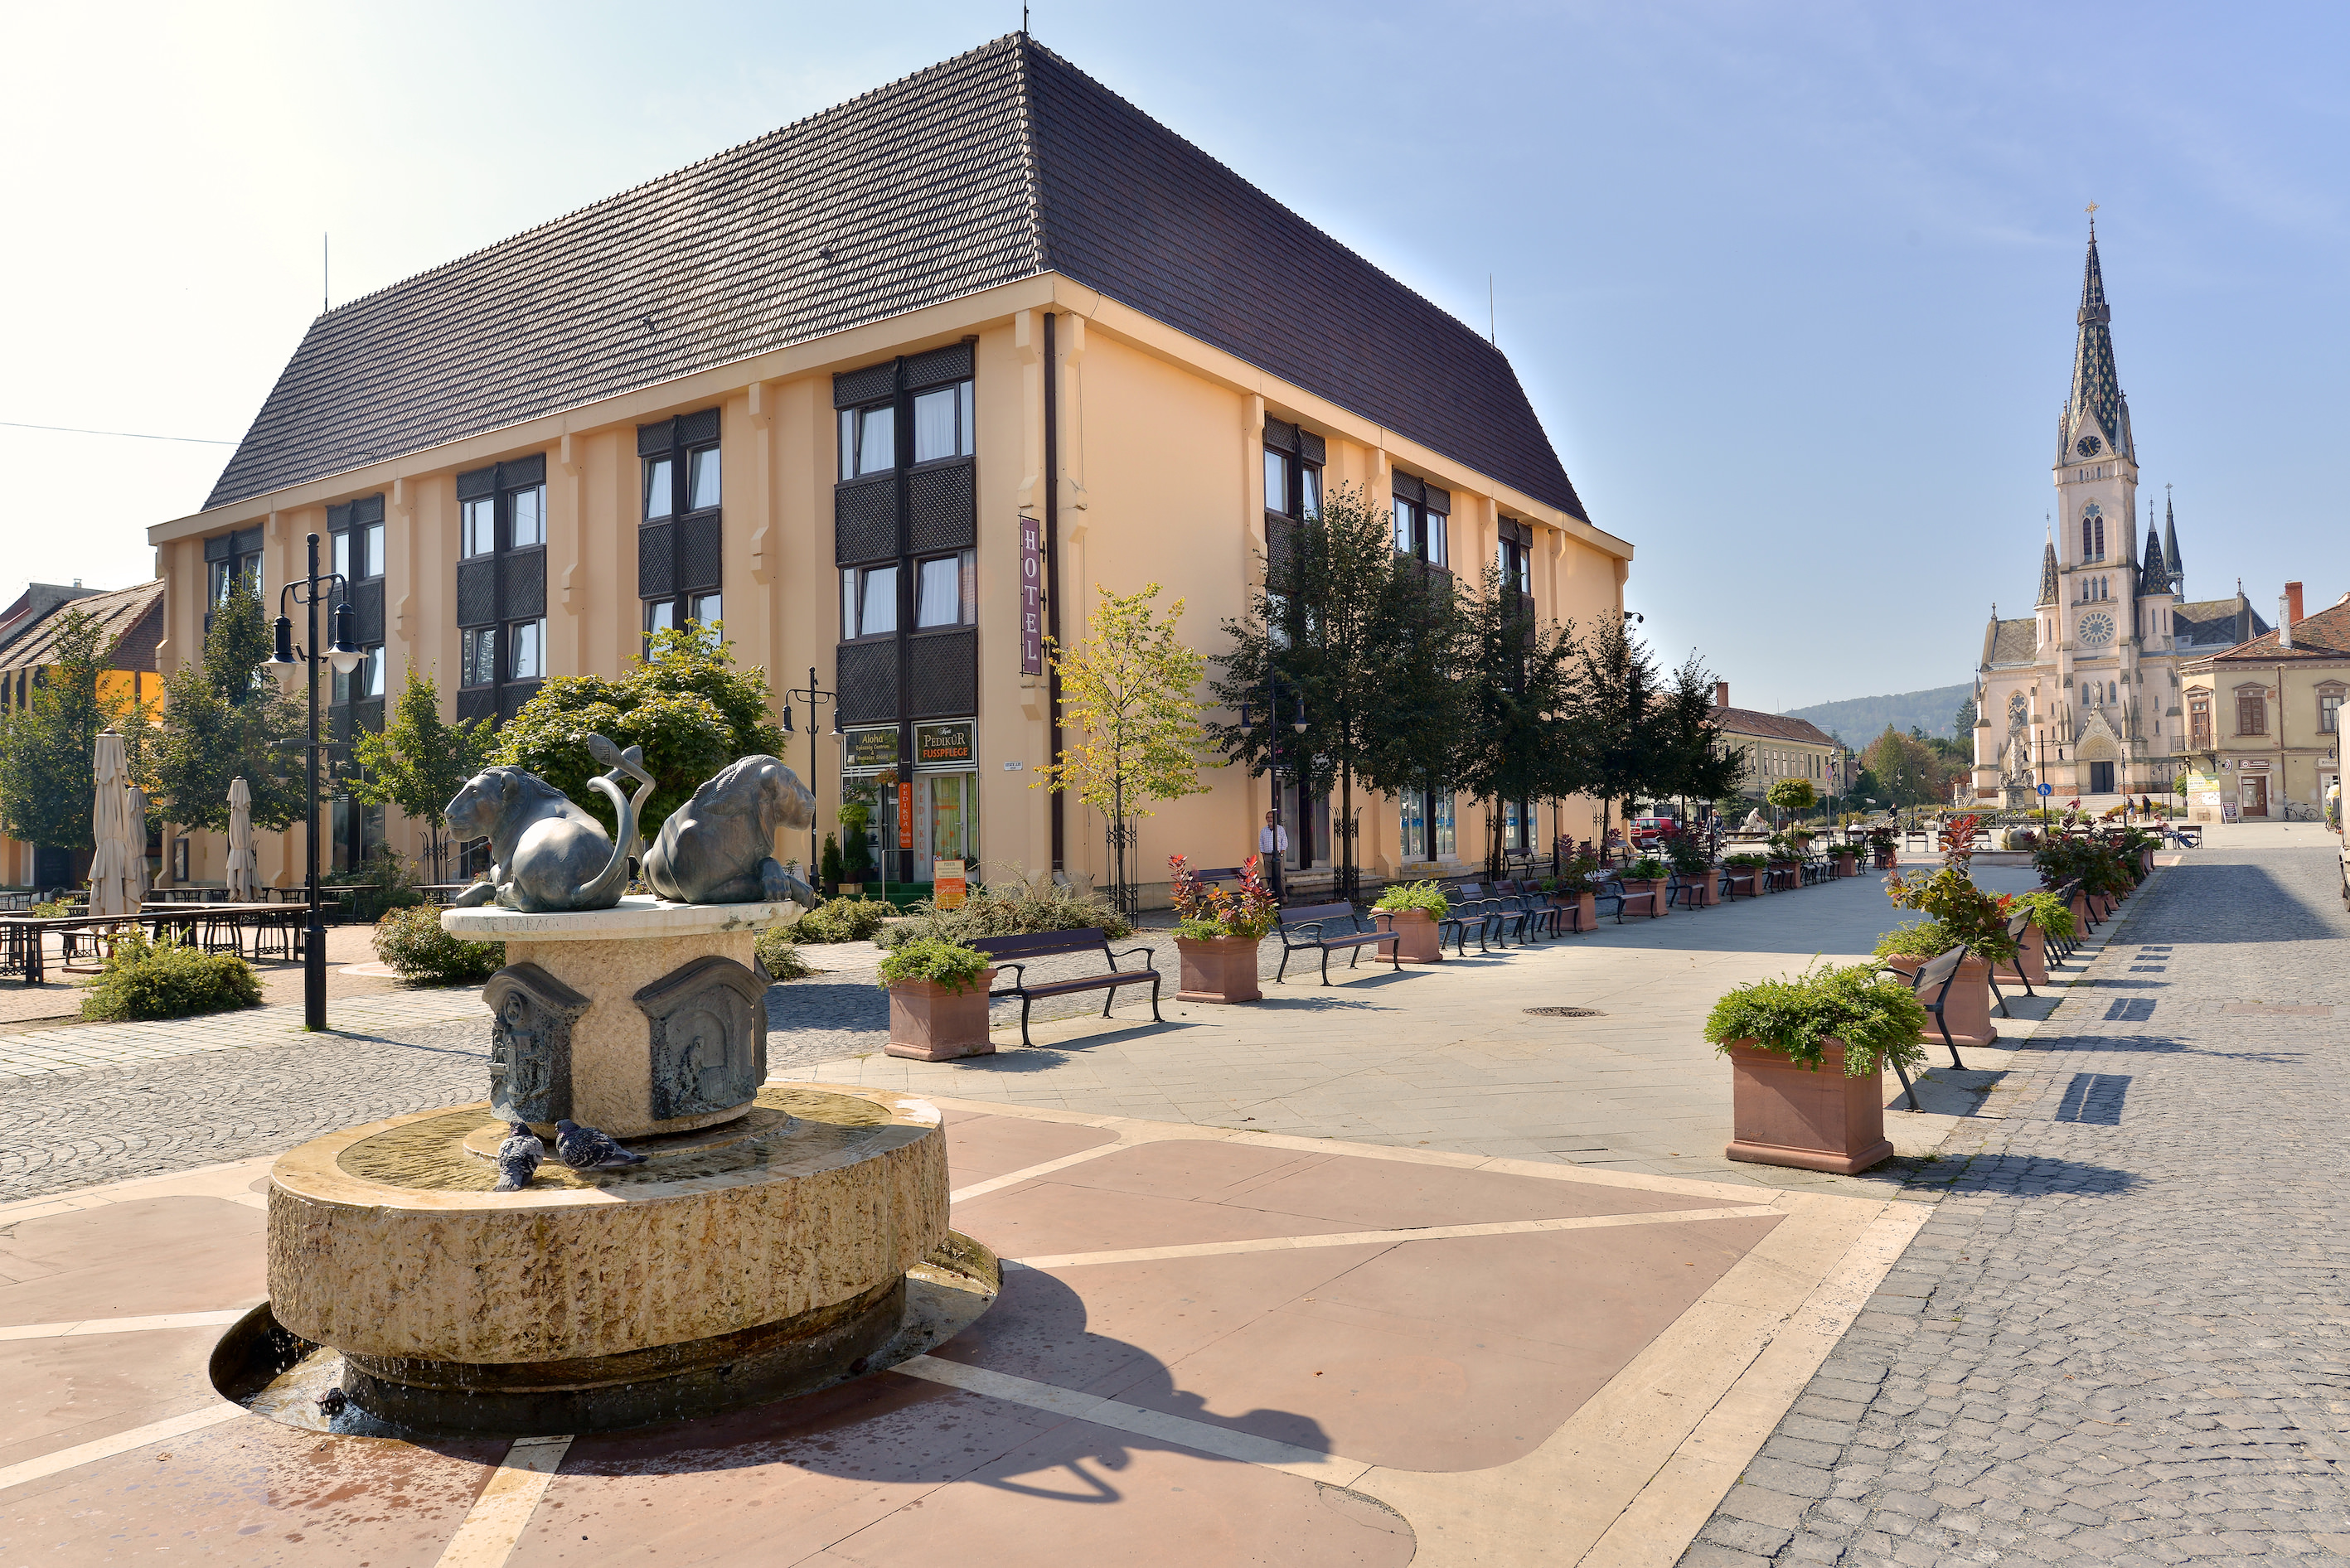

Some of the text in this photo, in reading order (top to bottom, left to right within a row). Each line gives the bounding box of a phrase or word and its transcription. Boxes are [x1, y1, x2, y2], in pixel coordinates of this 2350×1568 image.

[1025, 530, 1038, 661] HOTEL
[862, 733, 884, 743] Aloha
[923, 747, 968, 758] FUSSPFLEGE
